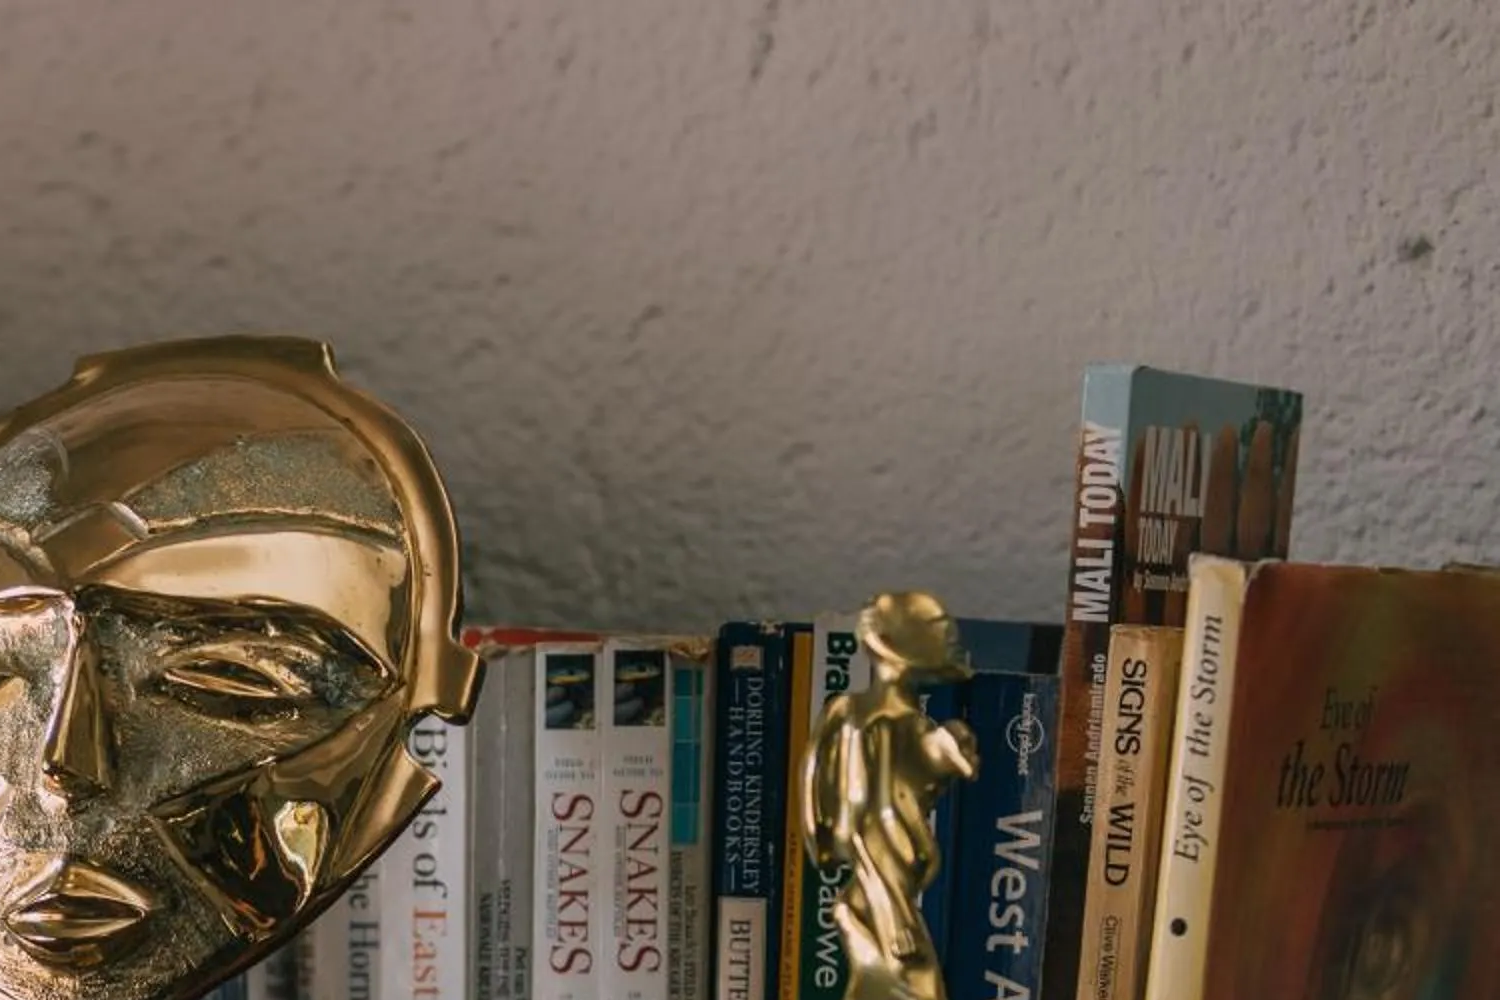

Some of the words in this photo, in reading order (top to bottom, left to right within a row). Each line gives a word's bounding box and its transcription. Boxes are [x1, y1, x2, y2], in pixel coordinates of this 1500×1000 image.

[1079, 420, 1123, 528] TODAY
[1139, 425, 1213, 517] MALI
[1072, 539, 1114, 623] MALI
[1137, 517, 1179, 565] TODAY
[825, 631, 859, 694] Bra
[1190, 613, 1224, 705] Storm
[745, 676, 765, 767] DORLING
[1114, 657, 1148, 757] SIGNS
[1185, 711, 1214, 758] the
[1320, 686, 1354, 741] Eye
[1353, 684, 1380, 732] of
[412, 728, 447, 840] Bis
[724, 706, 745, 864] HANDBOOKS
[1182, 774, 1215, 803] of
[1275, 738, 1326, 809] the
[1328, 742, 1411, 809] Storm
[412, 852, 447, 898] of
[742, 774, 763, 894] KINDERSLEY
[1104, 801, 1136, 888] WILD
[1174, 808, 1209, 864] Eye
[348, 871, 379, 911] he
[549, 792, 595, 975] SNAKES
[616, 788, 664, 974] SNAKES
[986, 810, 1044, 954] West
[412, 907, 447, 999] East
[1101, 914, 1119, 952] Clive
